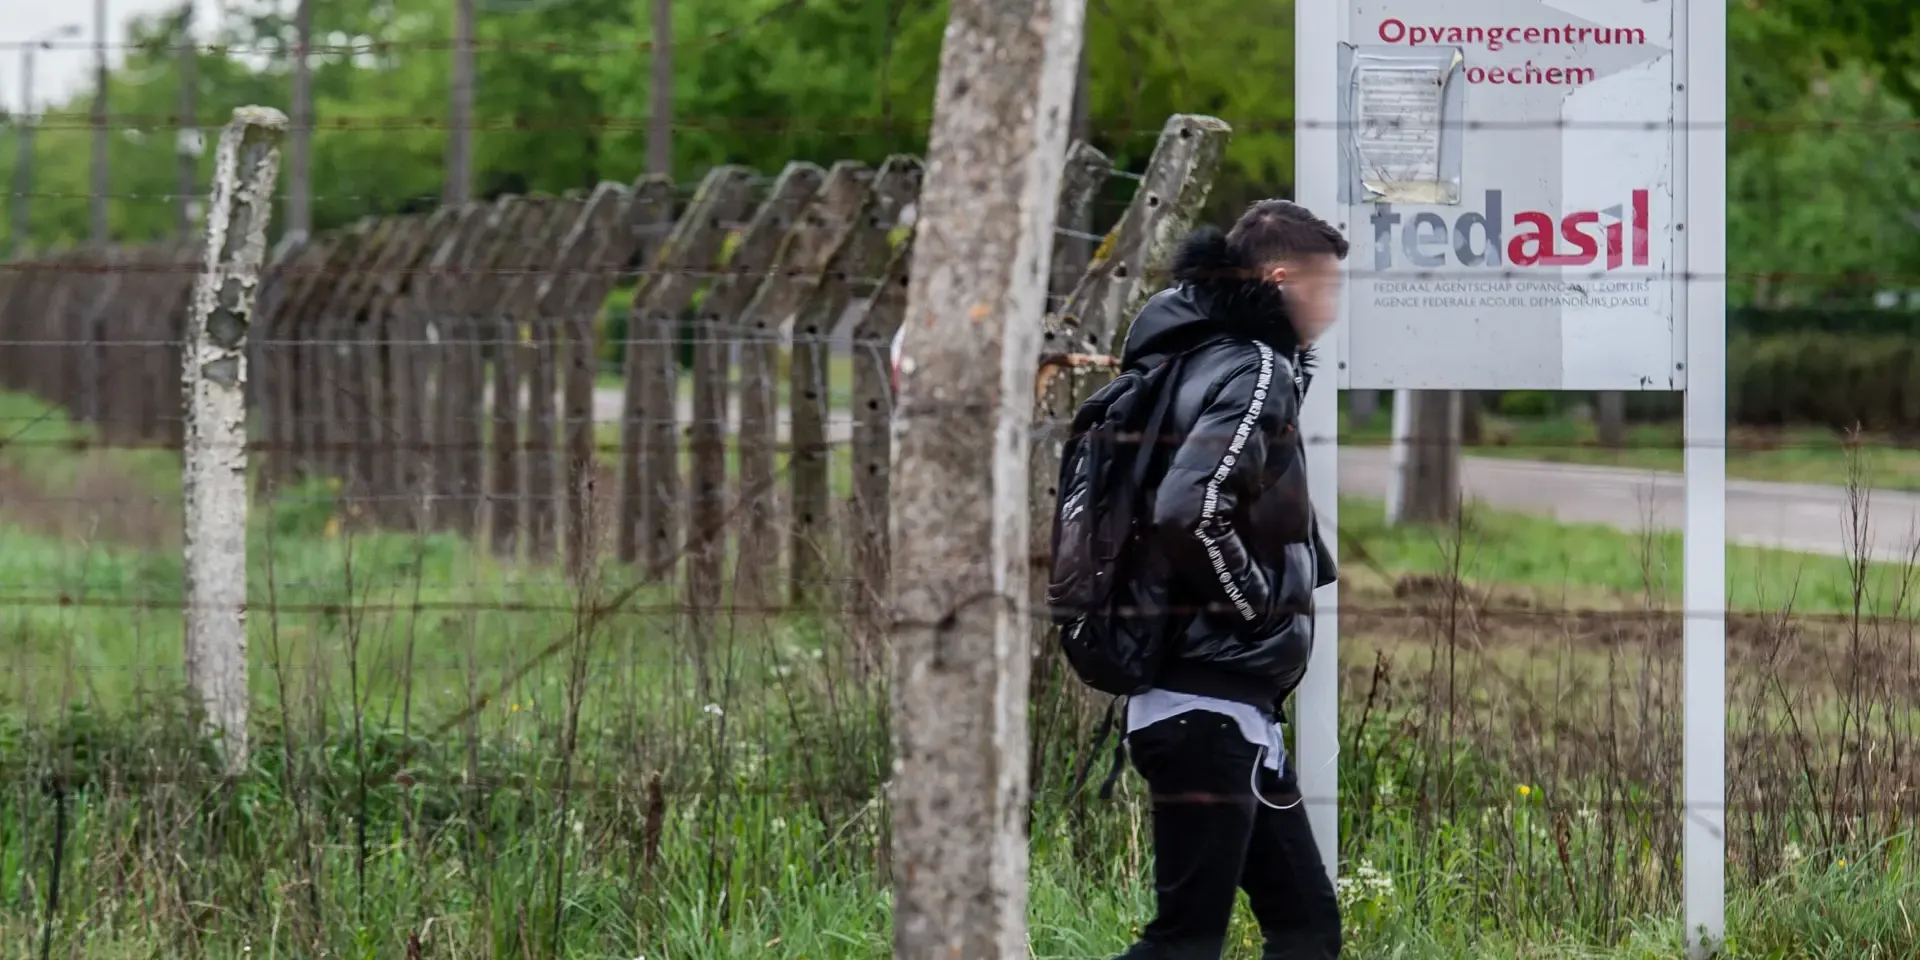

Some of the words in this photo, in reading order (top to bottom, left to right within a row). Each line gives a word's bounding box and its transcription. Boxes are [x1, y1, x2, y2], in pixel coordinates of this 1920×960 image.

[1378, 18, 1645, 51] Opvangcentrum
[1463, 60, 1595, 85] oechem
[1369, 189, 1649, 271] fedasil
[1373, 282, 1431, 293] FEDERAAL
[1433, 282, 1512, 293] AGENTSCHAP
[1373, 297, 1419, 308] AGENCE
[1422, 297, 1477, 308] FEDERALE
[1479, 297, 1525, 308] ACCUEIL
[1529, 296, 1607, 307] DEMANDEURS
[1610, 296, 1650, 308] D'ASILE
[1208, 545, 1227, 574] PHILIPP
[1243, 399, 1264, 425] PLEIN
